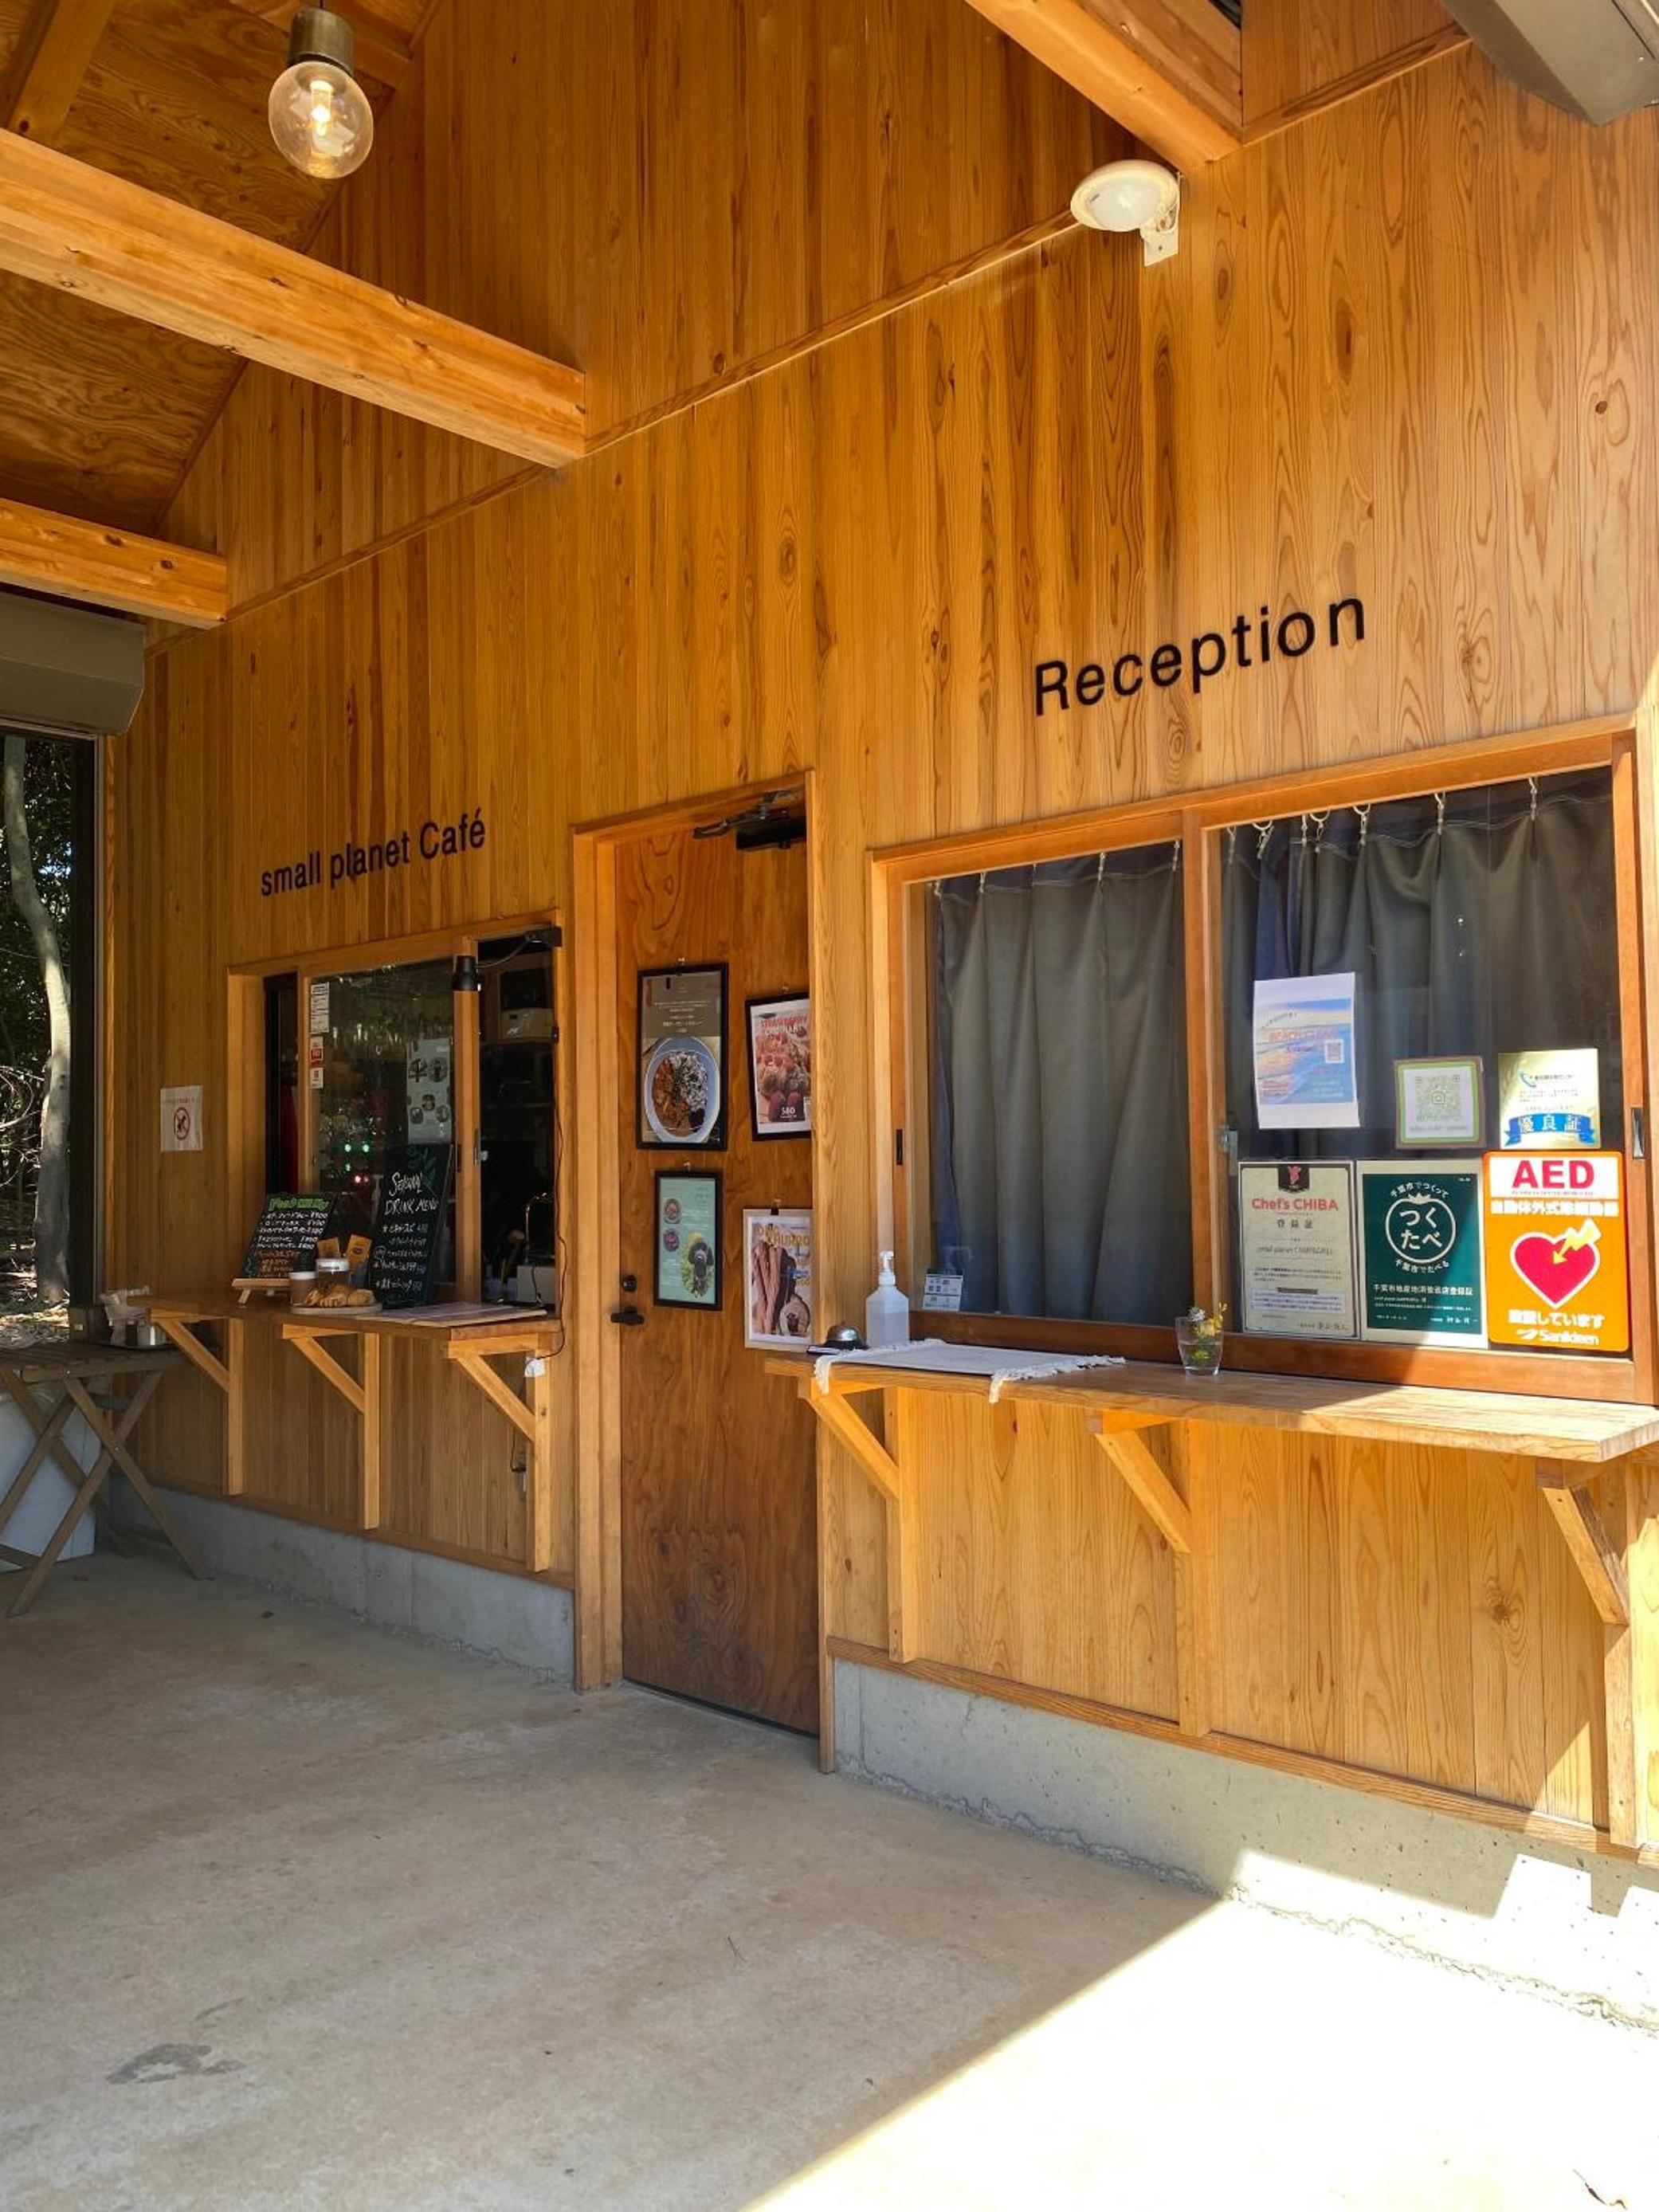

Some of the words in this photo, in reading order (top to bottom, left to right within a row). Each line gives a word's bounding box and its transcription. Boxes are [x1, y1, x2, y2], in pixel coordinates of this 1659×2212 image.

[1036, 597, 1365, 716] Reception
[261, 850, 320, 896] small
[330, 831, 410, 889] planet
[419, 807, 485, 859] Café
[1519, 1113, 1581, 1133] 優良証
[1512, 1160, 1595, 1190] AED
[1251, 1198, 1290, 1210] Chef's
[1292, 1198, 1339, 1211] CHIBA
[1399, 1207, 1437, 1228] つく
[1400, 1230, 1443, 1249] たべ
